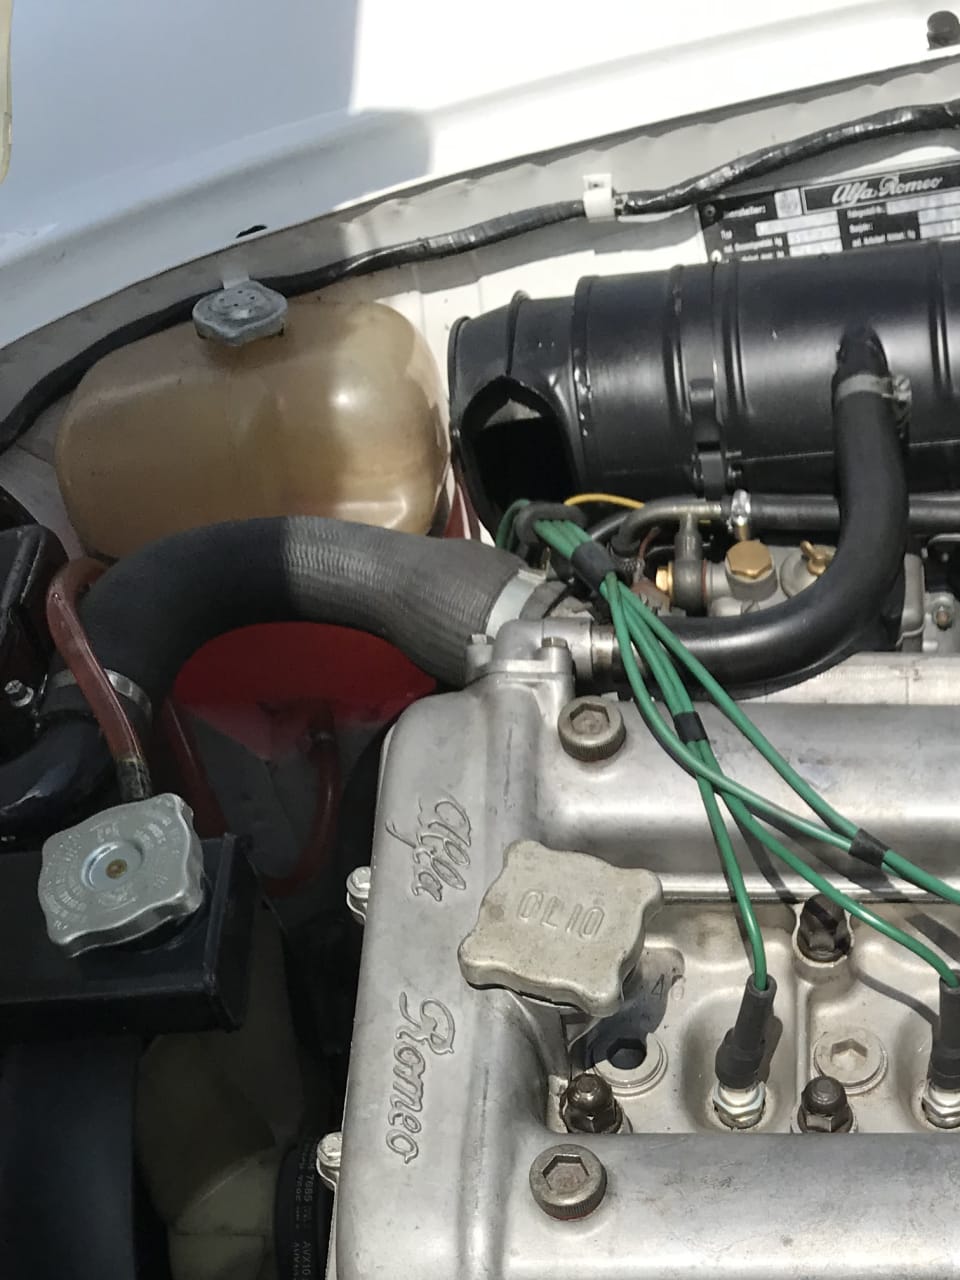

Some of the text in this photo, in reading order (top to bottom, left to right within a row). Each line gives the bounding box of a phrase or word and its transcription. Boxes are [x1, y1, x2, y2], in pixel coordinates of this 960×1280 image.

[831, 174, 944, 205] Alfa Romeo
[384, 799, 473, 902] Alfa
[518, 888, 606, 941] OLIO
[385, 990, 456, 1165] Romeo
